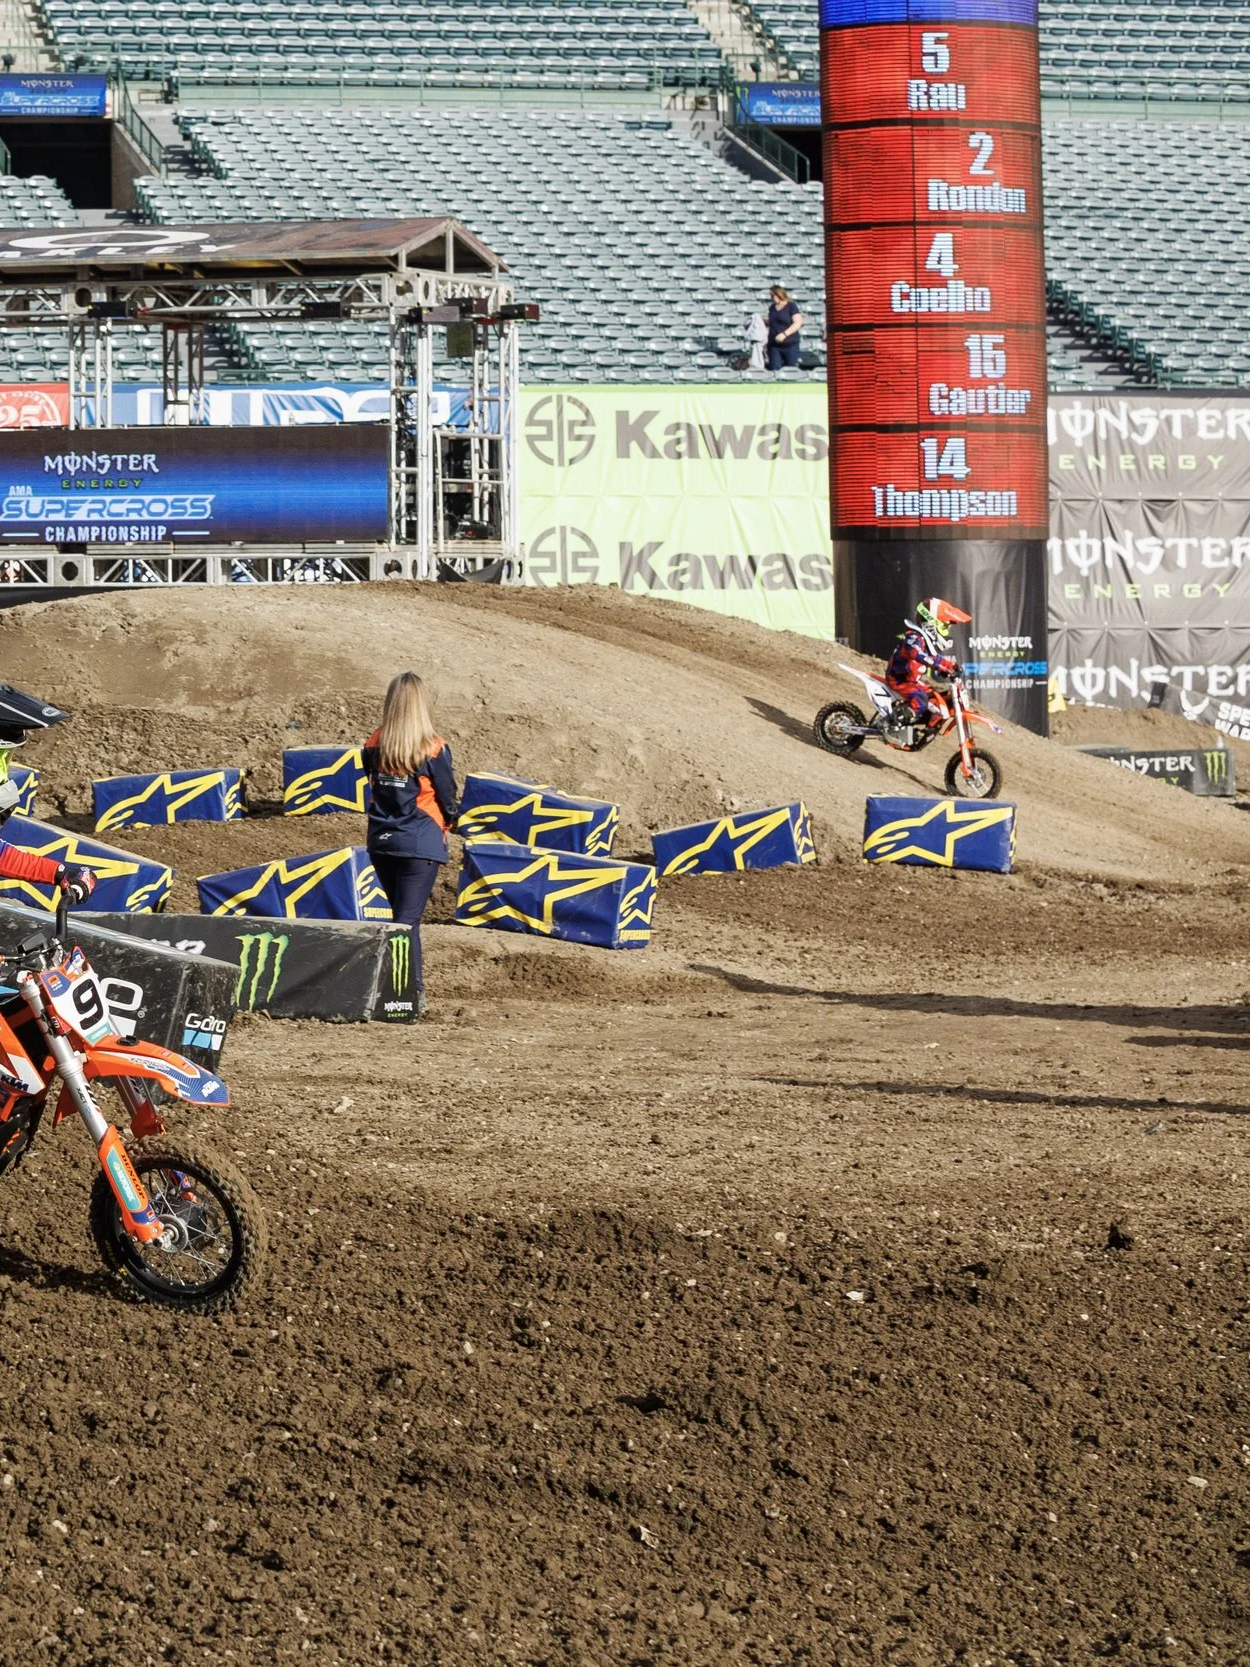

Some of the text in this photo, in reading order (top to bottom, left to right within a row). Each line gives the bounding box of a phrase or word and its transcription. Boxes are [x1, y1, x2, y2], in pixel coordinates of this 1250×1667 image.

[921, 32, 950, 73] 5
[907, 79, 966, 111] Rau
[968, 132, 994, 175] 2
[925, 233, 959, 276] 4
[890, 280, 991, 313] Coelho
[615, 410, 830, 461] Kawas
[44, 451, 160, 476] MONSTER
[920, 438, 972, 481] 14
[1058, 454, 1224, 470] ENERGY
[8, 485, 33, 497] AMA
[62, 479, 144, 489] ENERGY
[0, 496, 214, 520] SUPERCROSS
[871, 484, 1018, 521] Thompson
[45, 525, 167, 542] CHAMPIONSHIP
[619, 541, 835, 591] Kawas
[1064, 583, 1231, 599] ENERGY
[969, 635, 1033, 650] MONSTER
[966, 679, 1034, 689] CHAMPIONSHIP
[1110, 755, 1196, 775] NSTER
[72, 978, 104, 1031] 9
[0, 1074, 30, 1092] KTM
[120, 1154, 146, 1200] DUNLOP
